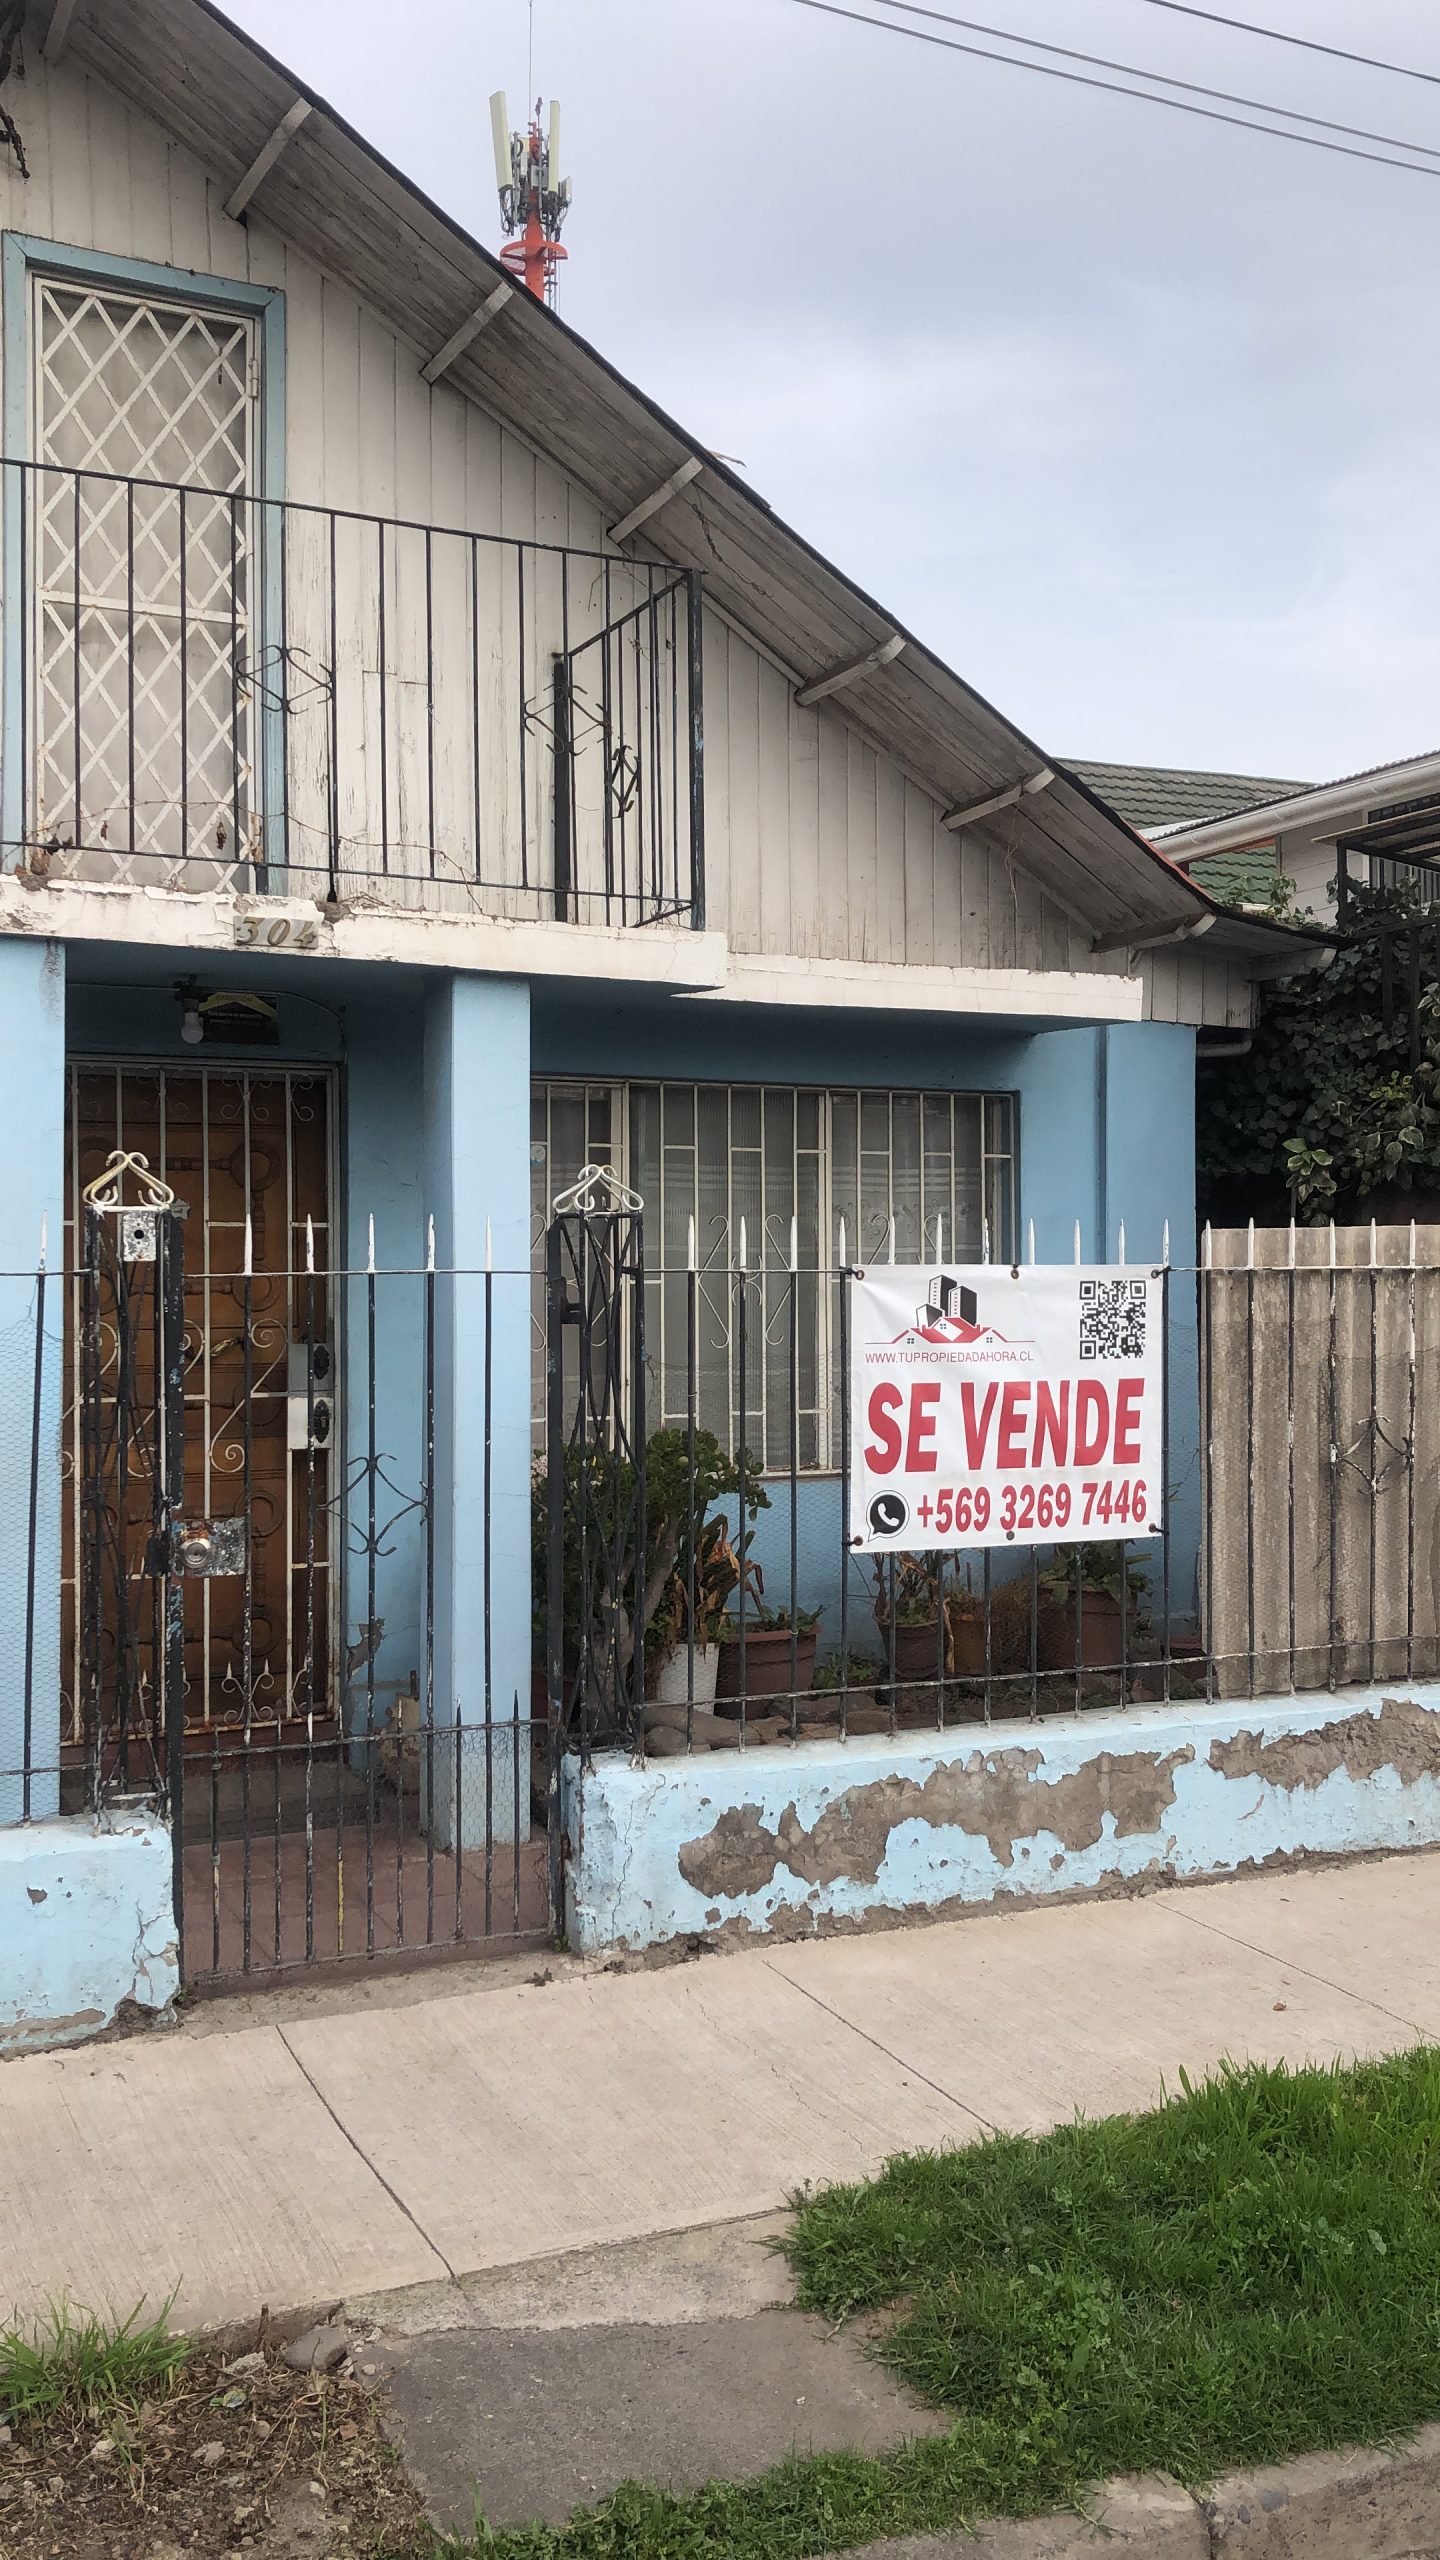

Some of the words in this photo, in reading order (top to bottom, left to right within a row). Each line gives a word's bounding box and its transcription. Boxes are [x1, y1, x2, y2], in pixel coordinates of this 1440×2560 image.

[236, 916, 316, 947] 304
[865, 1350, 1034, 1364] WWW.TUPROPIEDADAHORA.CL
[864, 1382, 941, 1474] SE
[960, 1378, 1145, 1471] VENDE
[917, 1487, 991, 1534] +569
[1000, 1483, 1071, 1531] 3269
[1081, 1479, 1147, 1526] 7446
